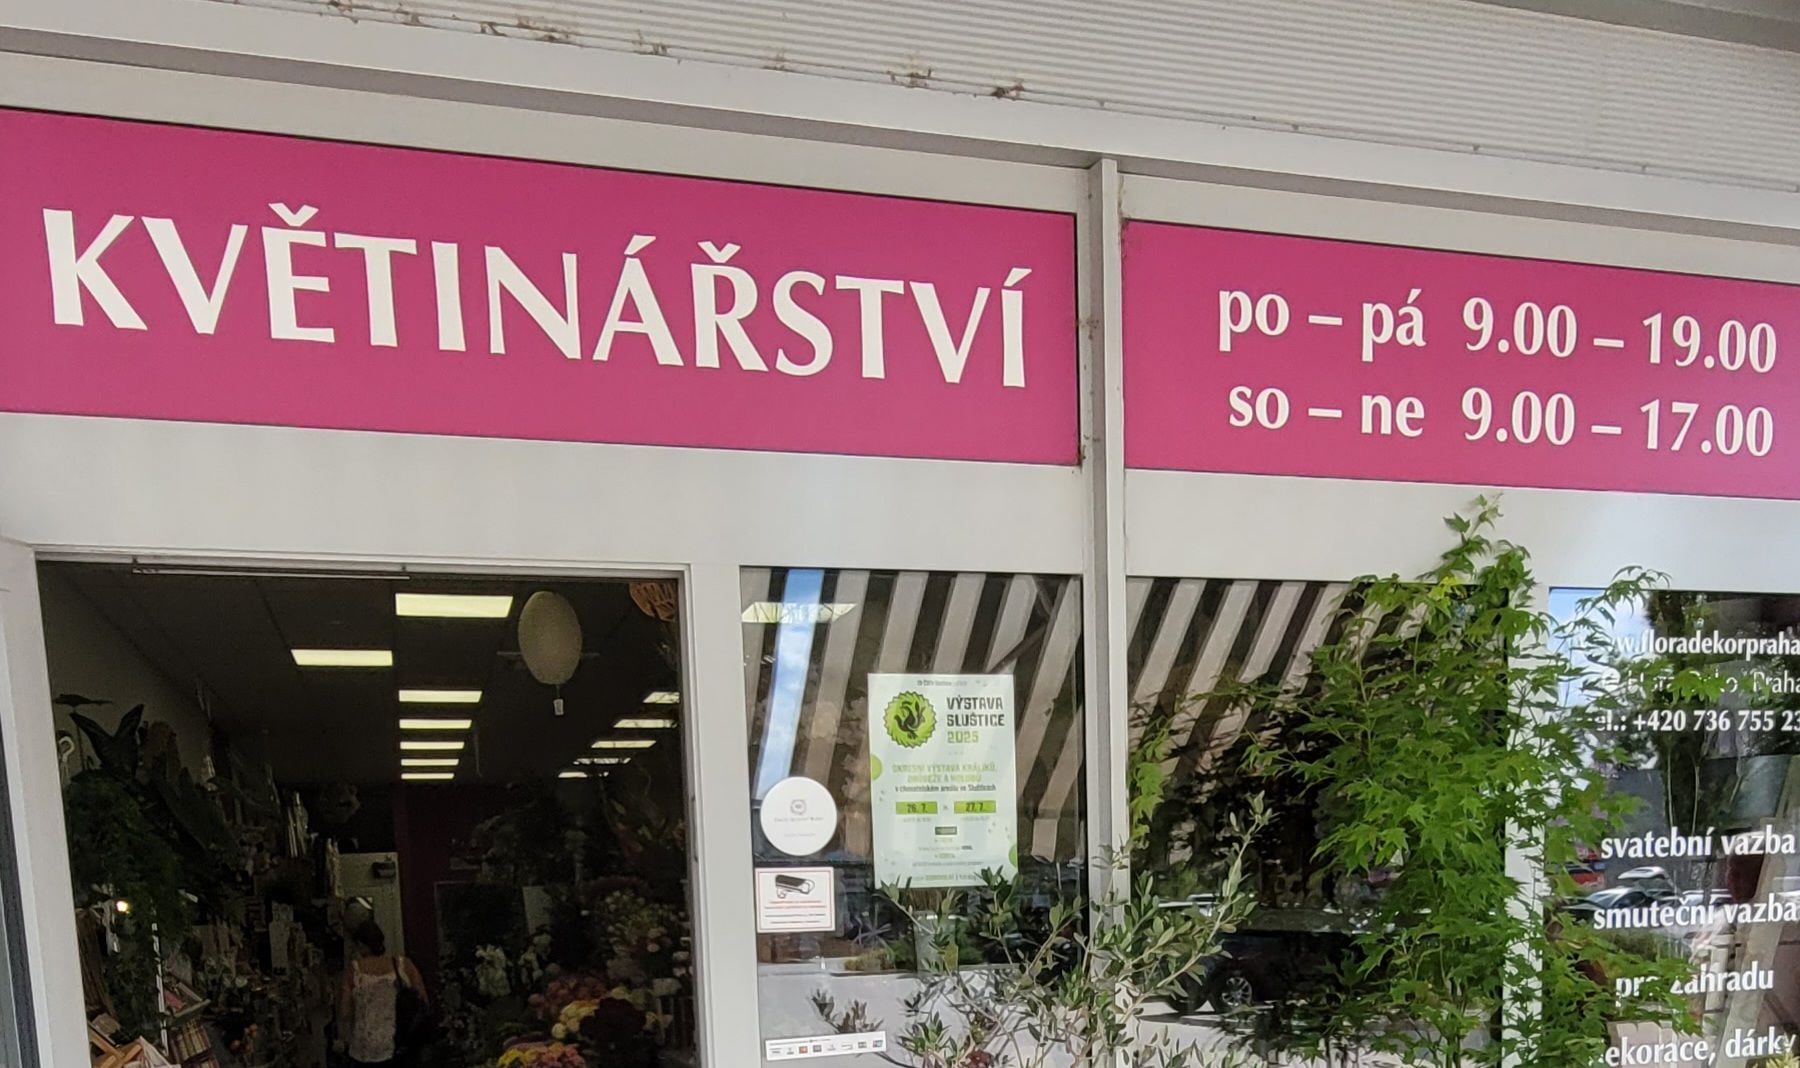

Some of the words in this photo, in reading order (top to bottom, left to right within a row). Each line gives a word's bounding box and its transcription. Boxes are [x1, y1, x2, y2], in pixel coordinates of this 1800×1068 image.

[43, 203, 1033, 388] KVĚTINÁŘSTVÍ
[1218, 289, 1291, 353] po
[1361, 288, 1427, 362] pá
[1462, 296, 1578, 358] 9.00
[1642, 312, 1777, 373] 19.00
[1228, 385, 1291, 429] so
[1360, 393, 1426, 438] ne
[1461, 387, 1577, 445] 9.00
[1640, 398, 1774, 457] 17.00
[946, 694, 1003, 710] VÝSTAVA
[946, 712, 1005, 727] SLUŠTICE
[947, 731, 979, 743] 2025
[1586, 709, 1627, 731] el.:
[1633, 709, 1686, 732] +420
[1693, 709, 1731, 731] 736
[1737, 709, 1775, 731] 755
[1600, 826, 1716, 859] svatební
[1721, 824, 1796, 855] vazba
[1593, 897, 1714, 929] smuteční
[1725, 893, 1799, 923] vazba
[1615, 975, 1660, 1007] pr
[1590, 1036, 1716, 1066] ekorace,
[1725, 1026, 1797, 1059] dárky
